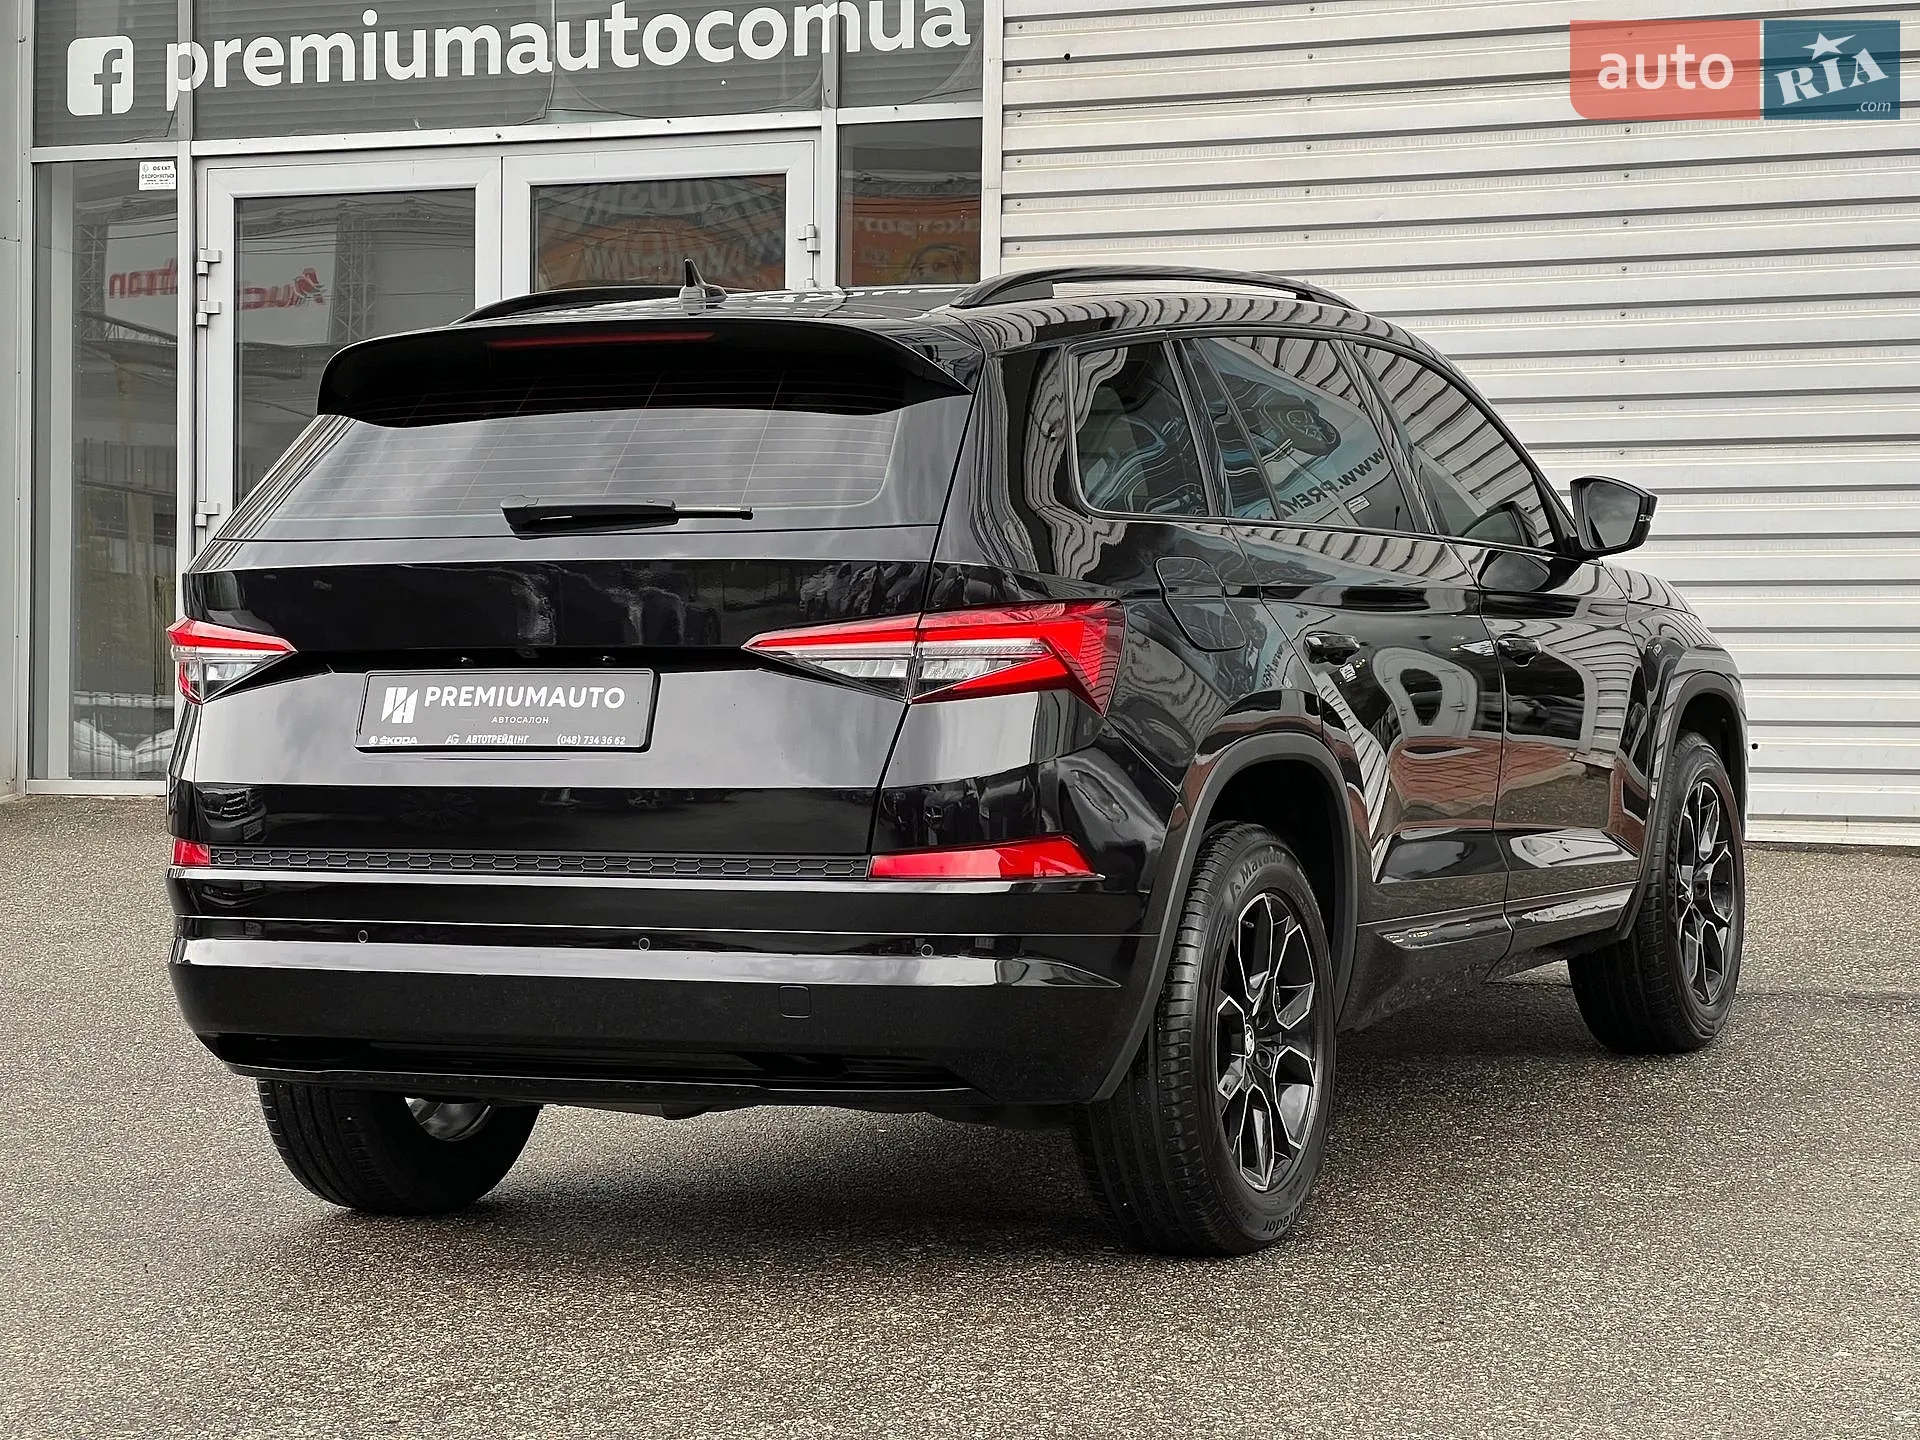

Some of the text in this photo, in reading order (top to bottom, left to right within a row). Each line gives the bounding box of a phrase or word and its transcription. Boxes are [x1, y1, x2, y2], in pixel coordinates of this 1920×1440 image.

[424, 686, 626, 709] PREMIUMAUTO
[491, 716, 550, 725] АВТОСАЛОН
[556, 733, 626, 745] (048) 734 36 62
